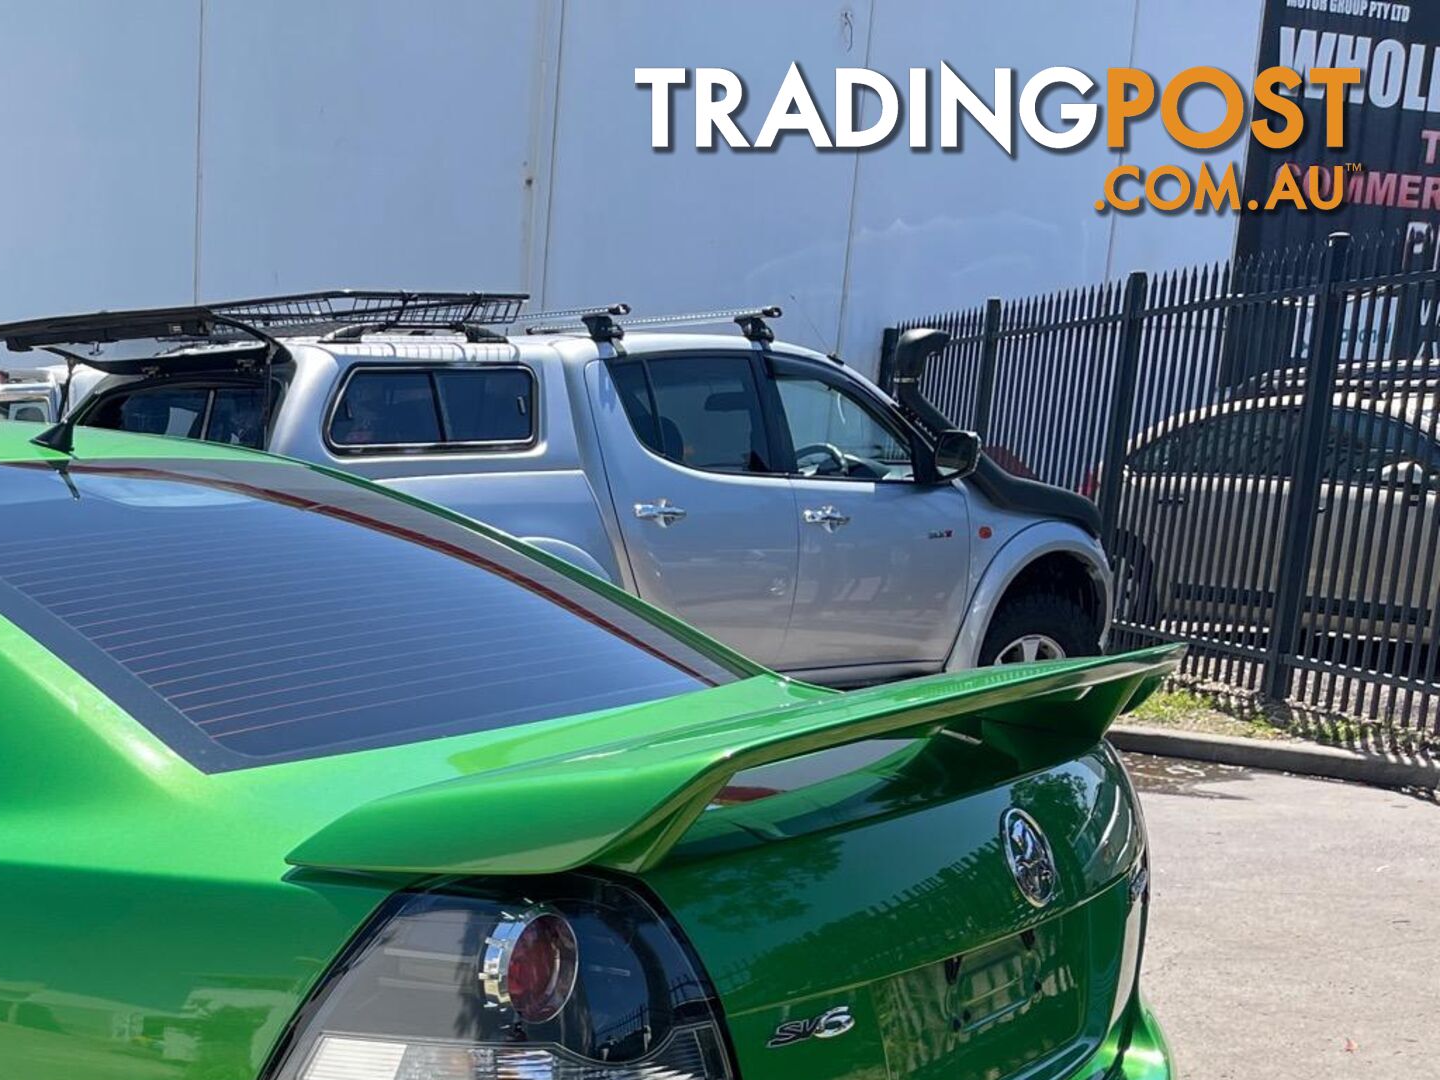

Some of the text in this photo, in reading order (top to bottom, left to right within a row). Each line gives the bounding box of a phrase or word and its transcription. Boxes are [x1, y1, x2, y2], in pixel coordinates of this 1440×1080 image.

[1329, 0, 1368, 16] GROUP
[1368, 1, 1391, 20] PTY
[1390, 4, 1411, 22] LTD
[766, 1005, 856, 1049] SV6
